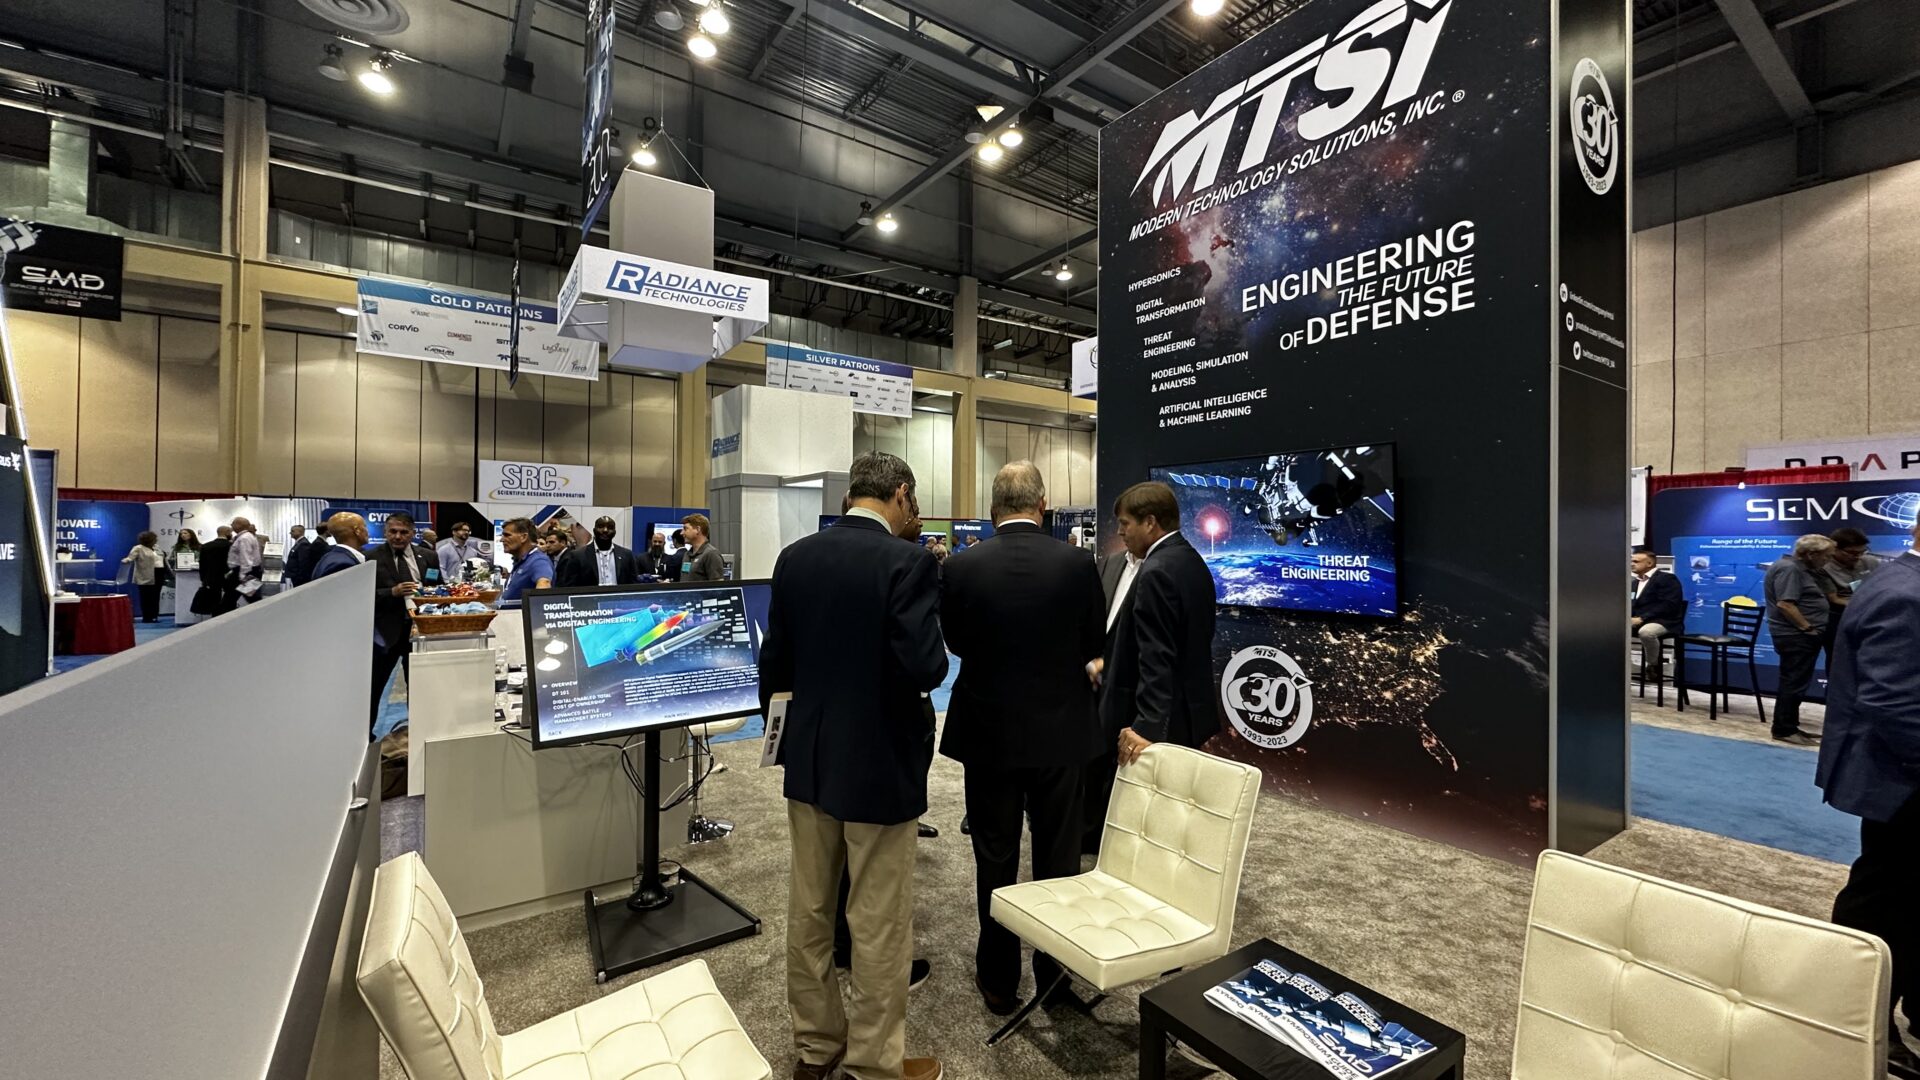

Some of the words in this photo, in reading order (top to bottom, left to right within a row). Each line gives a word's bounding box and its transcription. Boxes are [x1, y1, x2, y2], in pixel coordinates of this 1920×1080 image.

[1130, 0, 1453, 208] MTSI
[1128, 205, 1183, 242] MODERN
[1184, 160, 1289, 217] TECHNOLOGY
[1287, 112, 1397, 175] SOLUTIONS,
[1402, 90, 1446, 126] INC.
[22, 266, 105, 290] SMD
[1242, 220, 1475, 313] ENGINEERING
[608, 261, 752, 300] RADIANCE
[1128, 267, 1181, 292] HYPERSONICS
[1337, 281, 1378, 307] THE
[1381, 254, 1475, 296] FUTURE
[430, 294, 471, 308] GOLD
[644, 288, 745, 312] TECHNOLOGIES
[1136, 298, 1164, 313] DIGITAL
[1136, 297, 1206, 325] TRANSFORMATION
[1279, 330, 1305, 350] OF
[1307, 278, 1476, 345] DEFENSE
[1143, 338, 1196, 358] ENGINEERING
[1144, 331, 1173, 346] THREAT
[805, 353, 838, 366] SILVER
[839, 359, 881, 372] PATRONS
[1151, 364, 1194, 380] MODELING,
[1196, 351, 1249, 371] SIMULATION
[1151, 384, 1158, 393] &
[1159, 376, 1197, 391] ANALYSIS
[1159, 400, 1202, 415] ARTIFICIAL
[1203, 388, 1268, 408] INTELLIGENCE
[1159, 419, 1166, 428] &
[1167, 413, 1204, 427] MACHINE
[1206, 406, 1252, 421] LEARNING
[501, 463, 557, 491] SRC
[1317, 554, 1370, 568] THREAT
[1281, 567, 1370, 582] ENGINEERING
[543, 602, 574, 611] DIGITAL
[543, 609, 613, 620] TRANSFORMATION
[557, 619, 586, 628] DIGITAL
[587, 616, 637, 626] ENGINEERING
[1252, 647, 1278, 659] MTSI
[551, 680, 578, 688] OVERVIEW
[1240, 672, 1296, 718] 30
[1247, 712, 1283, 727] YEARS
[1242, 727, 1288, 746] 1993-2023
[1281, 1015, 1331, 1060] SYMPOSIUM
[1330, 1057, 1360, 1078] GUIDE
[1318, 1031, 1373, 1073] SMD
